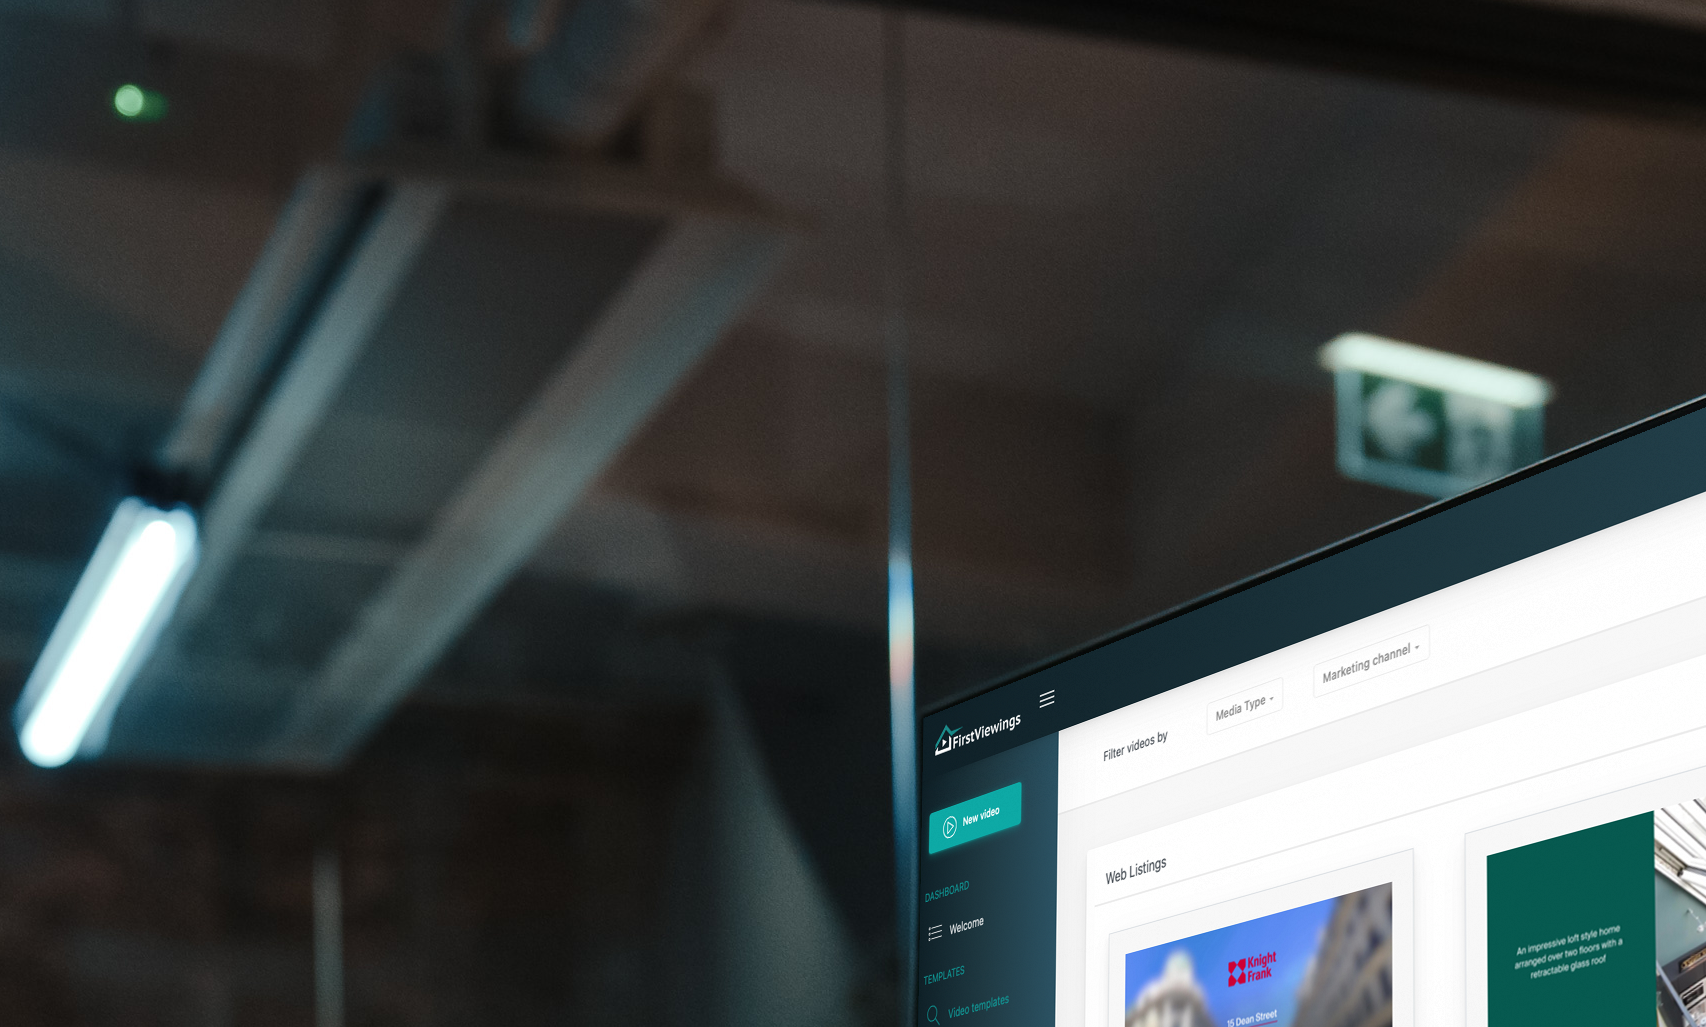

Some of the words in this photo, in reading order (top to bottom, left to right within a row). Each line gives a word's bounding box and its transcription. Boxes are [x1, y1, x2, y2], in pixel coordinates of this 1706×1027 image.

[1322, 658, 1370, 684] Marketing
[1372, 643, 1411, 666] channel
[1215, 703, 1242, 721] Media
[1243, 695, 1266, 711] Type
[953, 714, 1021, 749] FirstViewings
[1103, 745, 1125, 761] Filter
[1127, 736, 1155, 754] videos
[1157, 731, 1168, 745] by
[963, 814, 978, 826] New
[980, 807, 999, 820] video
[1105, 869, 1127, 885] Web
[1129, 857, 1167, 879] Listings
[925, 881, 970, 902] DASHBOARD
[950, 917, 984, 935] Welcome
[1517, 947, 1526, 956] An
[1528, 938, 1566, 953] impressive
[1567, 934, 1579, 944] loft
[1581, 930, 1597, 941] style
[1599, 925, 1620, 936] home
[1247, 951, 1277, 969] Knight
[1515, 955, 1546, 970] arranged
[1548, 951, 1563, 962] over
[1564, 949, 1578, 958] two
[1579, 943, 1600, 955] floors
[1601, 939, 1616, 949] with
[1618, 938, 1623, 946] a
[924, 965, 965, 985] TEMPLATES
[1247, 966, 1272, 982] Frank
[1530, 963, 1569, 979] retractable
[1571, 959, 1590, 972] glass
[1591, 954, 1606, 965] roof
[948, 1006, 969, 1018] Video
[972, 995, 1009, 1012] templates
[1227, 1019, 1235, 1027] 15
[1236, 1015, 1254, 1026] Dean
[1256, 1009, 1277, 1022] Street
